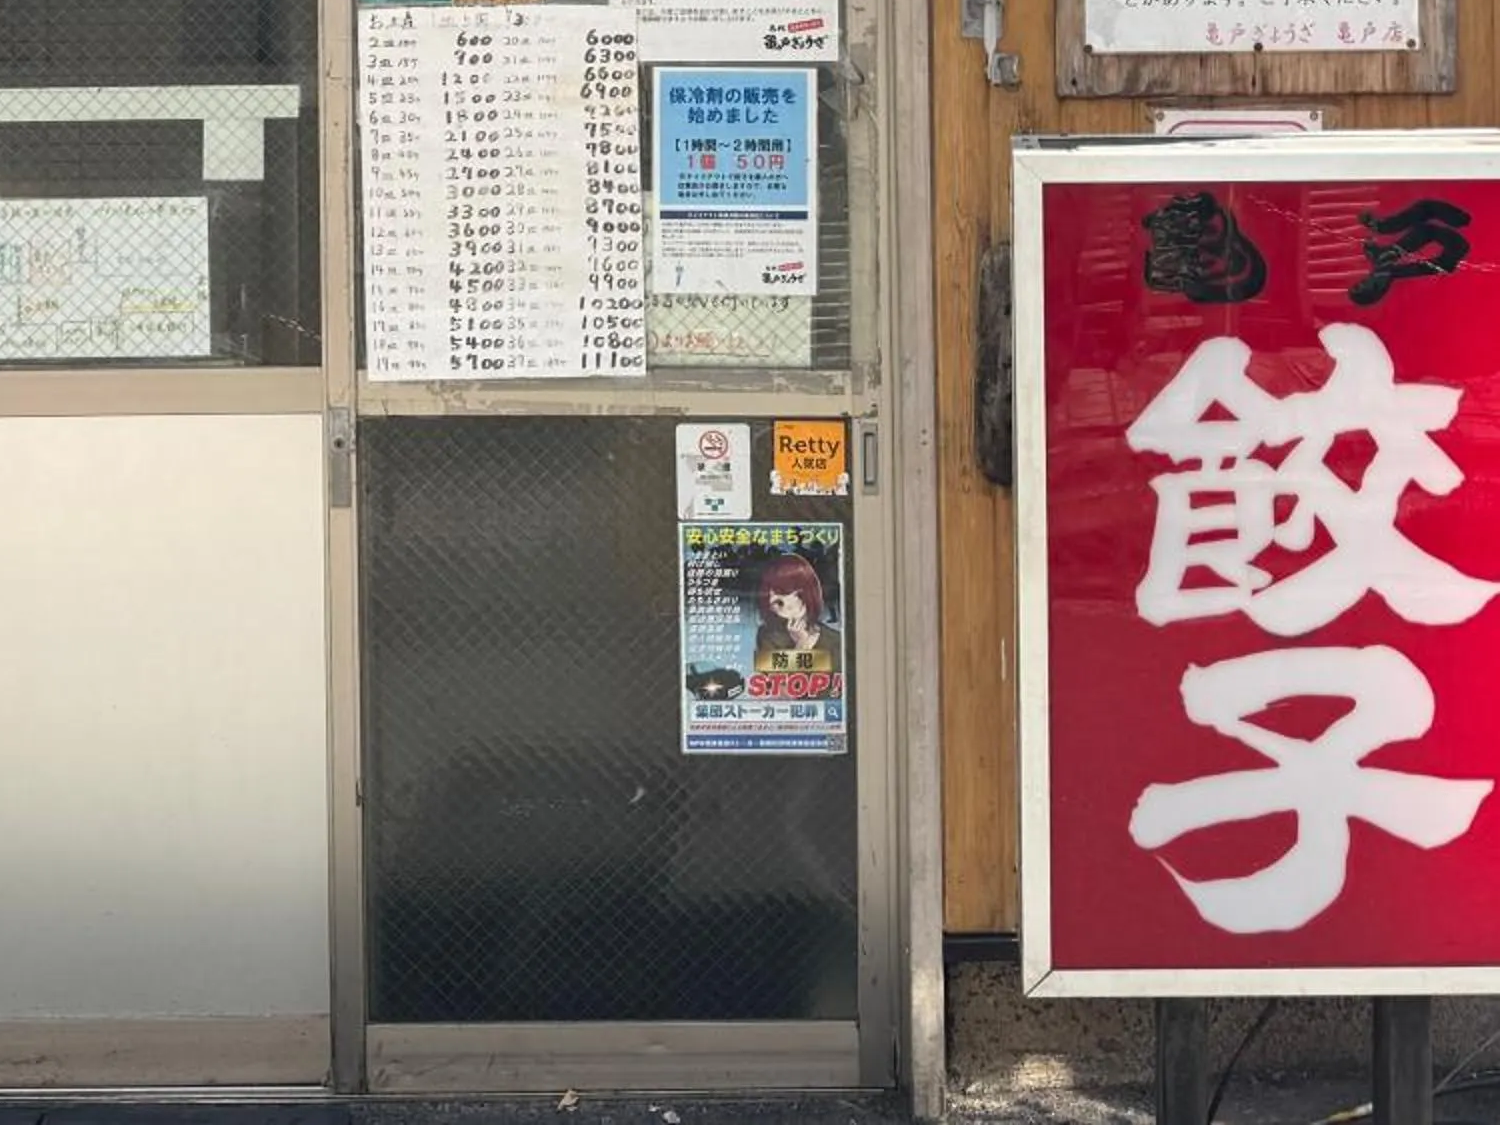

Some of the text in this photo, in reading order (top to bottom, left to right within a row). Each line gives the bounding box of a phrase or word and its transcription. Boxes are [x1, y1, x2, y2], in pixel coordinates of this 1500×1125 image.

[457, 31, 493, 47] 600
[586, 29, 634, 46] 6000
[1205, 21, 1405, 46] 亀戸ぎょうざ 亀戸店
[584, 47, 635, 64] 6300
[584, 67, 635, 81] 6600
[444, 91, 496, 105] 1500
[580, 82, 632, 99] 6900
[669, 86, 797, 105] 保冷剤の販売を
[446, 108, 498, 124] 1800
[688, 107, 779, 124] 始めました
[445, 129, 499, 143] 2100
[445, 148, 500, 161] 2400
[586, 140, 638, 157] 7800
[586, 160, 638, 175] 8100
[688, 154, 785, 170] 1個 50円
[446, 184, 501, 200] 3000
[587, 179, 639, 195] 8400
[447, 204, 501, 220] 3300
[585, 197, 641, 215] 8700
[448, 222, 501, 239] 3600
[586, 217, 640, 233] 9000
[448, 241, 502, 257] 3900
[1143, 190, 1472, 305] 亀戸
[449, 261, 504, 276] 4200
[449, 278, 504, 294] 4500
[589, 273, 638, 291] 9900
[449, 297, 503, 314] 4800
[580, 295, 643, 310] 10200
[450, 316, 503, 332] 5100
[582, 315, 643, 329] 10500
[450, 336, 504, 351] 5400
[583, 332, 644, 349] 10800
[451, 353, 504, 370] 5700
[582, 351, 643, 369] 11100
[779, 435, 840, 458] Retty
[686, 528, 838, 546] 安心安全なまちづくり
[1125, 322, 1500, 935] 餃子
[772, 653, 813, 669] 防犯
[696, 704, 818, 719] 集団ストーカー犯罪
